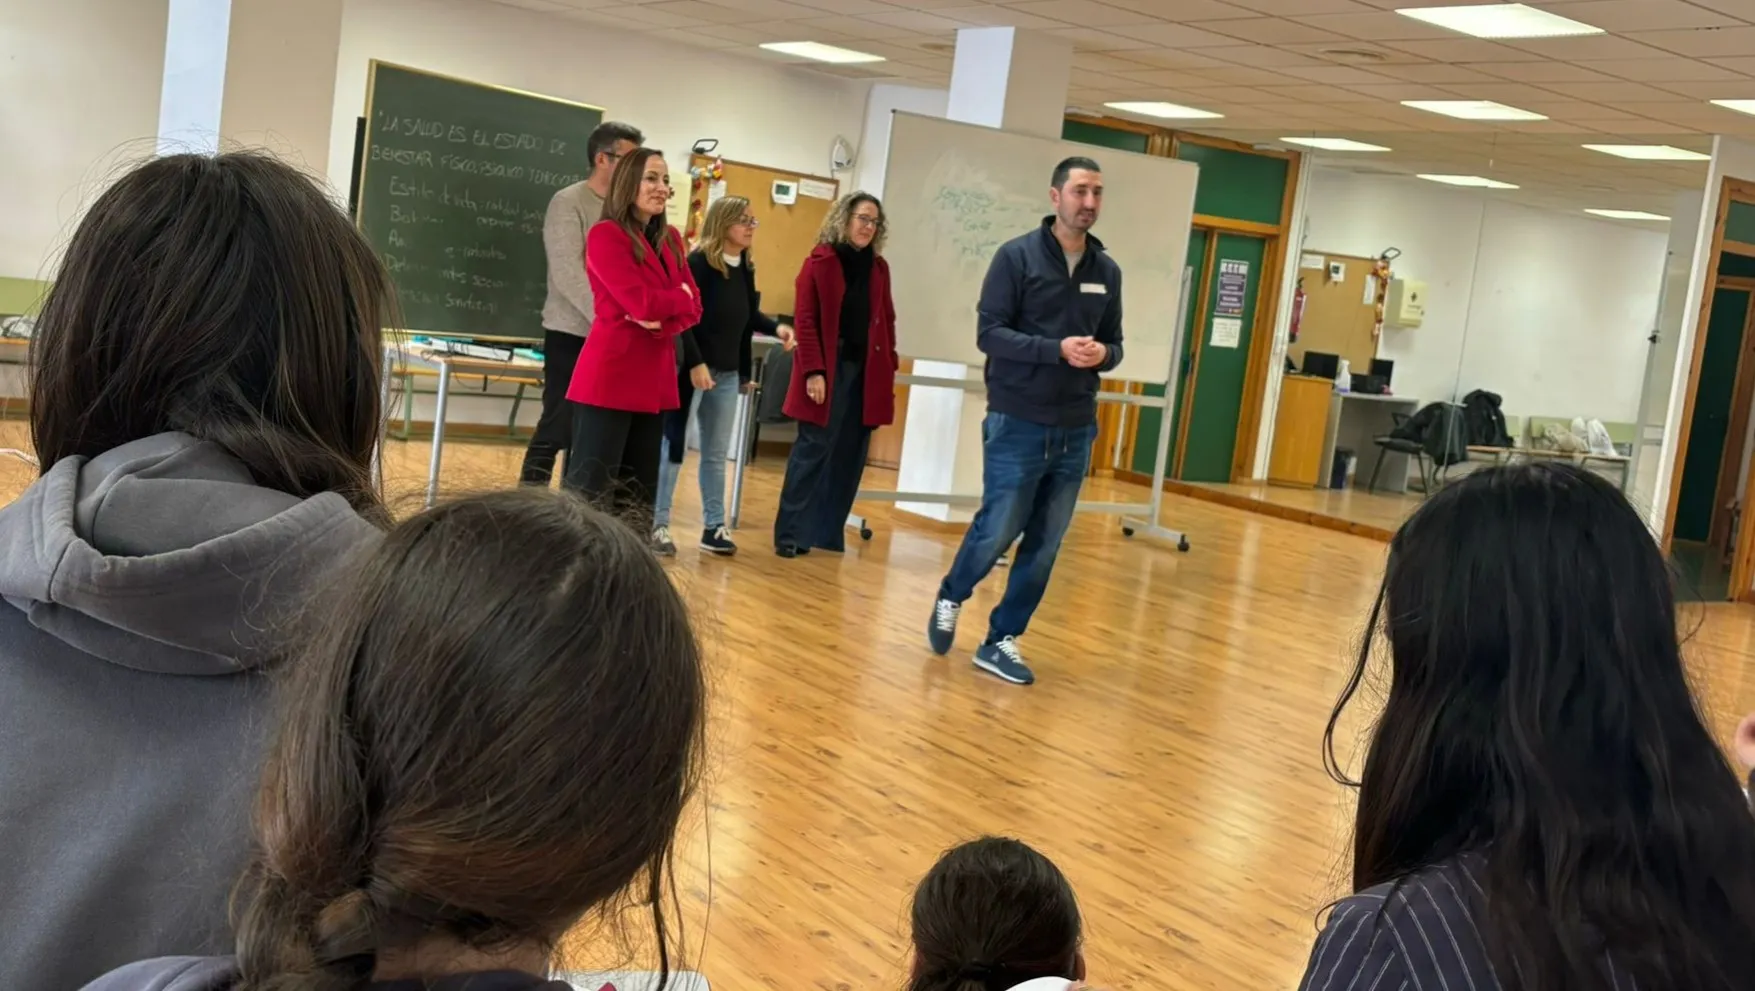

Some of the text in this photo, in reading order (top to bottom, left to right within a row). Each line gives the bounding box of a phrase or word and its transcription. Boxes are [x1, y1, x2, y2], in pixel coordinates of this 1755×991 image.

[403, 118, 444, 139] SALUD
[447, 124, 468, 143] ES
[473, 130, 491, 147] EL
[493, 132, 544, 150] ESTADO
